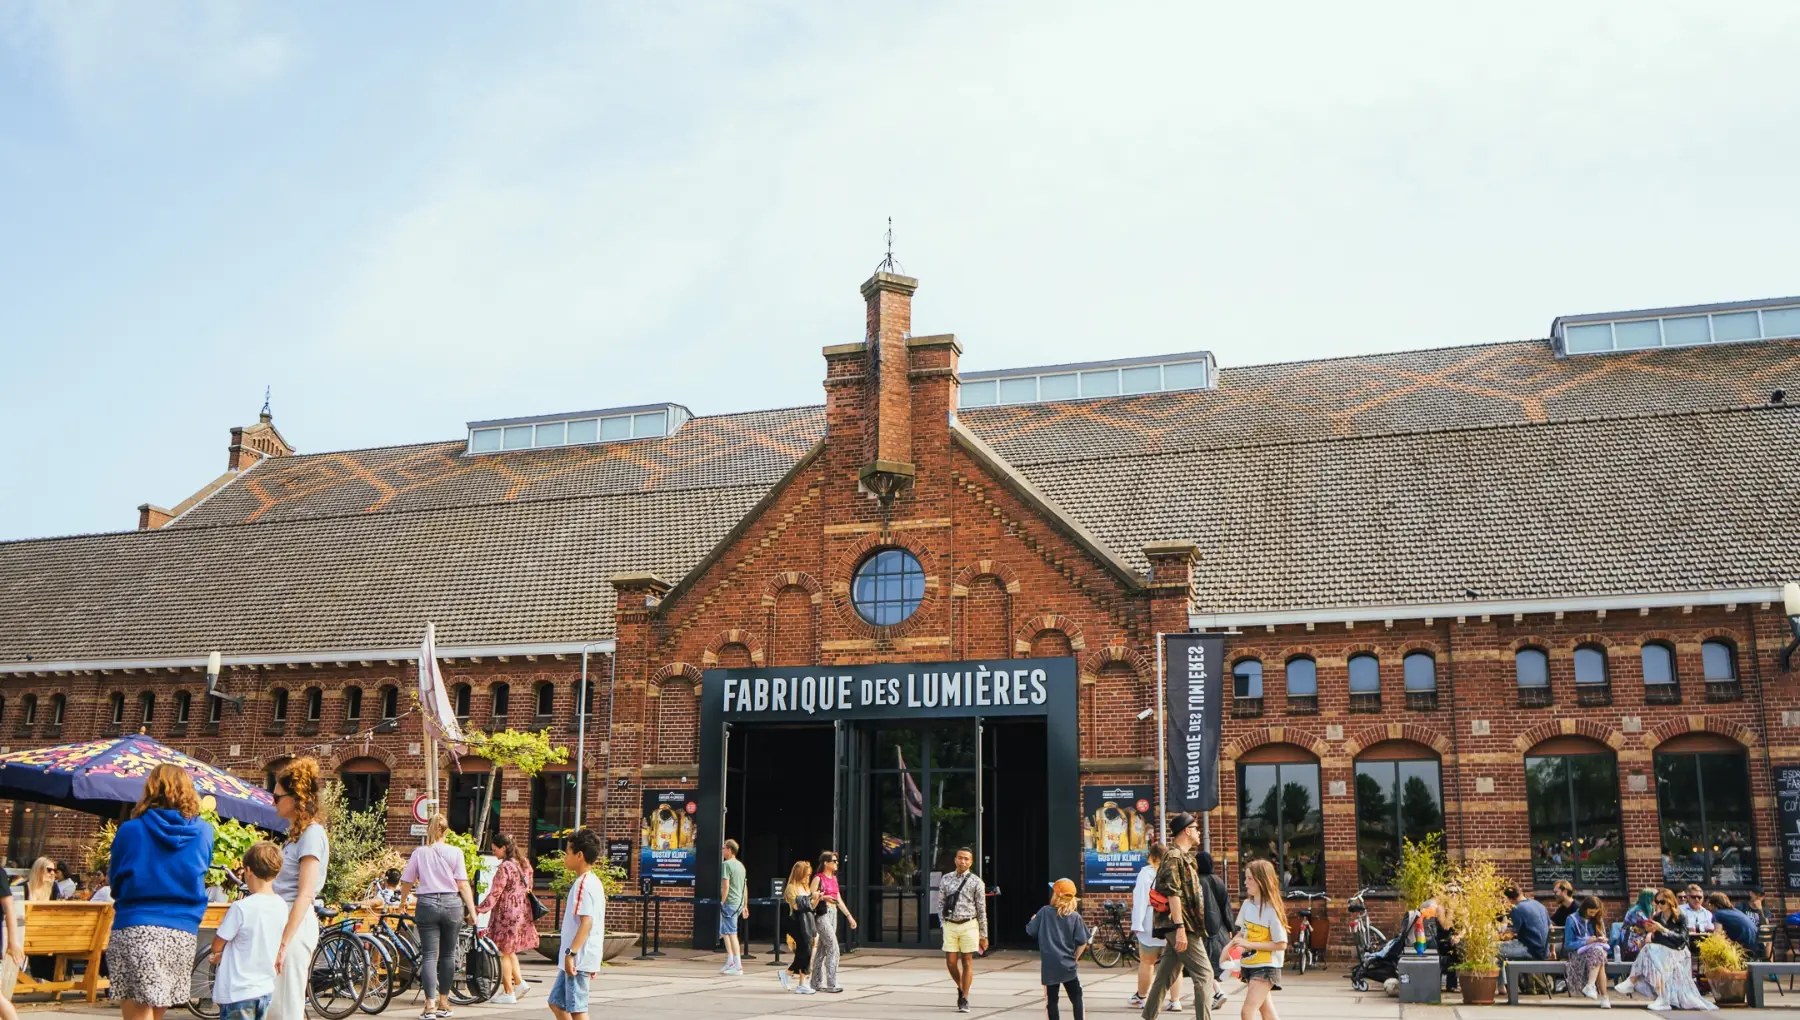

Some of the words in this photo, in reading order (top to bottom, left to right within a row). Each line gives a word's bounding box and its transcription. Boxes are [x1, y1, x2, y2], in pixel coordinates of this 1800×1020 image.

[723, 675, 853, 714] FABRIQUE
[861, 678, 900, 706] DES
[907, 664, 1048, 708] LUMIÈRES
